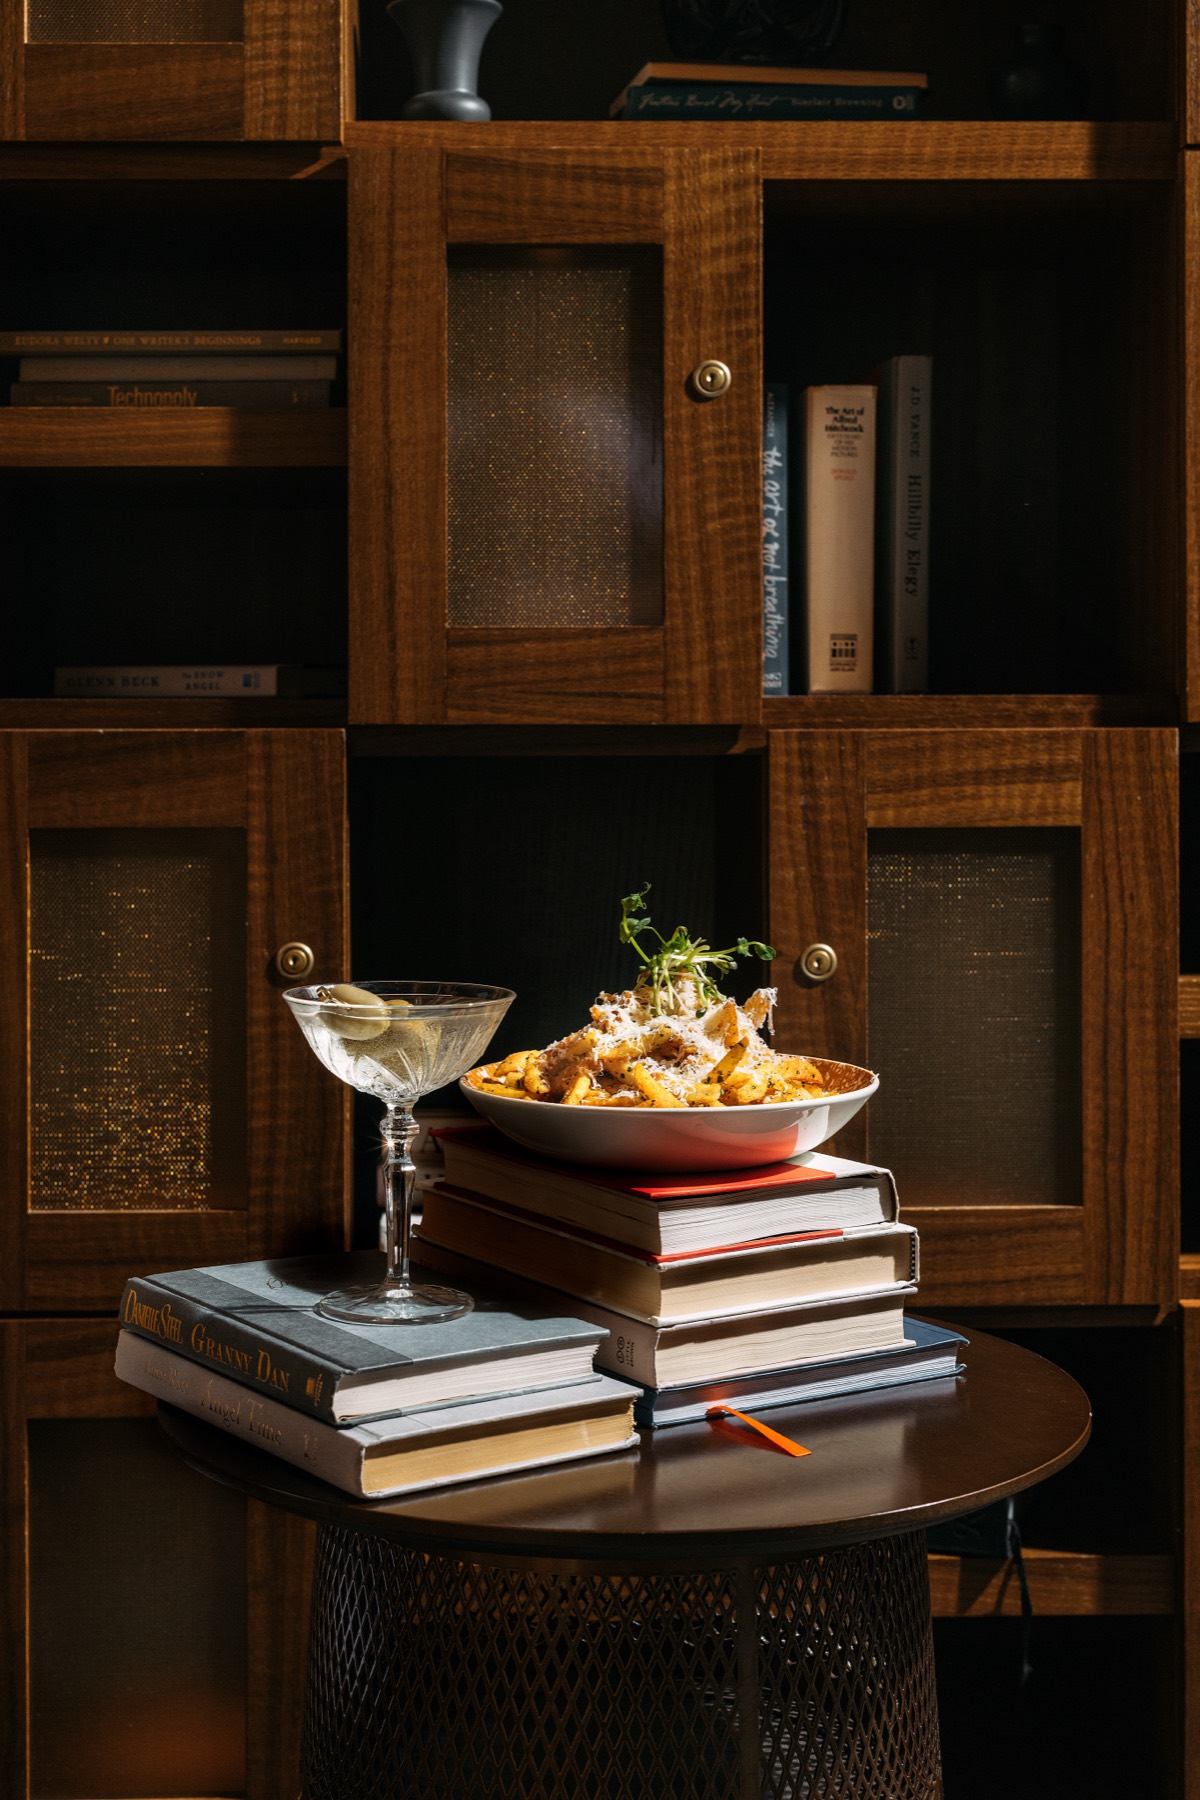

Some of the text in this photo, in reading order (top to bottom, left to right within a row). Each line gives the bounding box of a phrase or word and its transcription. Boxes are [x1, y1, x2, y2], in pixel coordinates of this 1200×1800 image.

[15, 335, 60, 346] EUDORA
[63, 335, 99, 346] WELTY
[113, 336, 136, 345] ONE
[193, 336, 262, 345] BEGINNINGS
[107, 385, 197, 406] Technopoly
[825, 406, 865, 415] The Art of
[766, 391, 775, 438] ALEXANDER
[825, 424, 864, 432] Hitchcock
[833, 415, 858, 424] Alfred
[910, 414, 921, 458] VANCE
[763, 446, 783, 476] the
[763, 479, 785, 517] art
[904, 475, 923, 597] Hillbilly Elegy
[763, 542, 781, 572] not
[66, 676, 159, 687] GLENN BECK
[185, 682, 220, 690] ANGEL
[124, 1289, 184, 1344] DANIELLE STEEL
[190, 1323, 253, 1375] GRANNY
[255, 1349, 290, 1392] DAN
[201, 1378, 282, 1446] Angel Time
